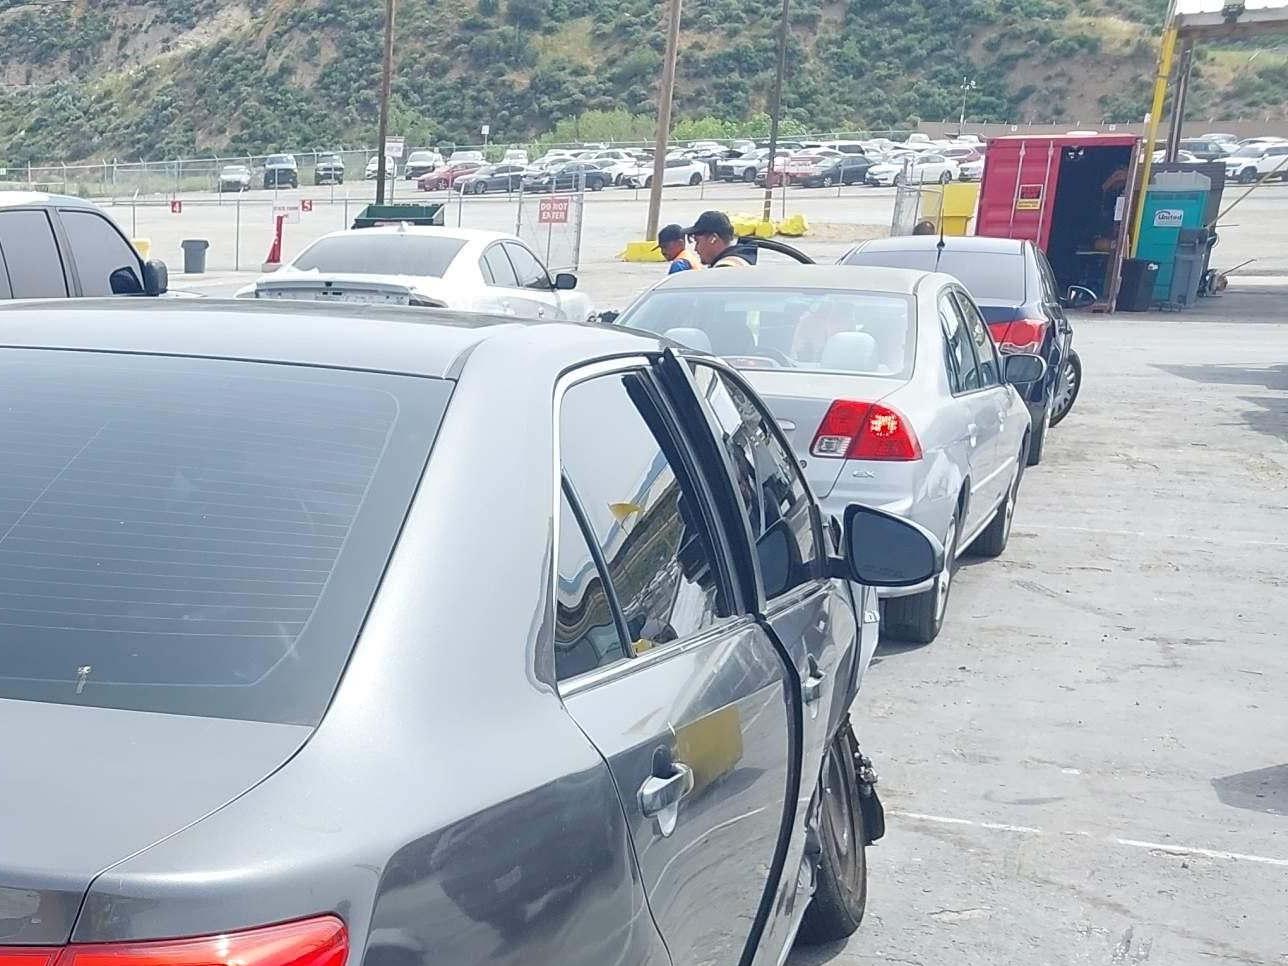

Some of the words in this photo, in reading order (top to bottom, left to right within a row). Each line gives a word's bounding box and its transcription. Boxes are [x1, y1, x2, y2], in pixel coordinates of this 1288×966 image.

[172, 201, 181, 213] 4
[303, 200, 312, 211] 5
[540, 202, 552, 211] DO
[552, 202, 569, 211] NOT
[541, 211, 566, 220] ENTER
